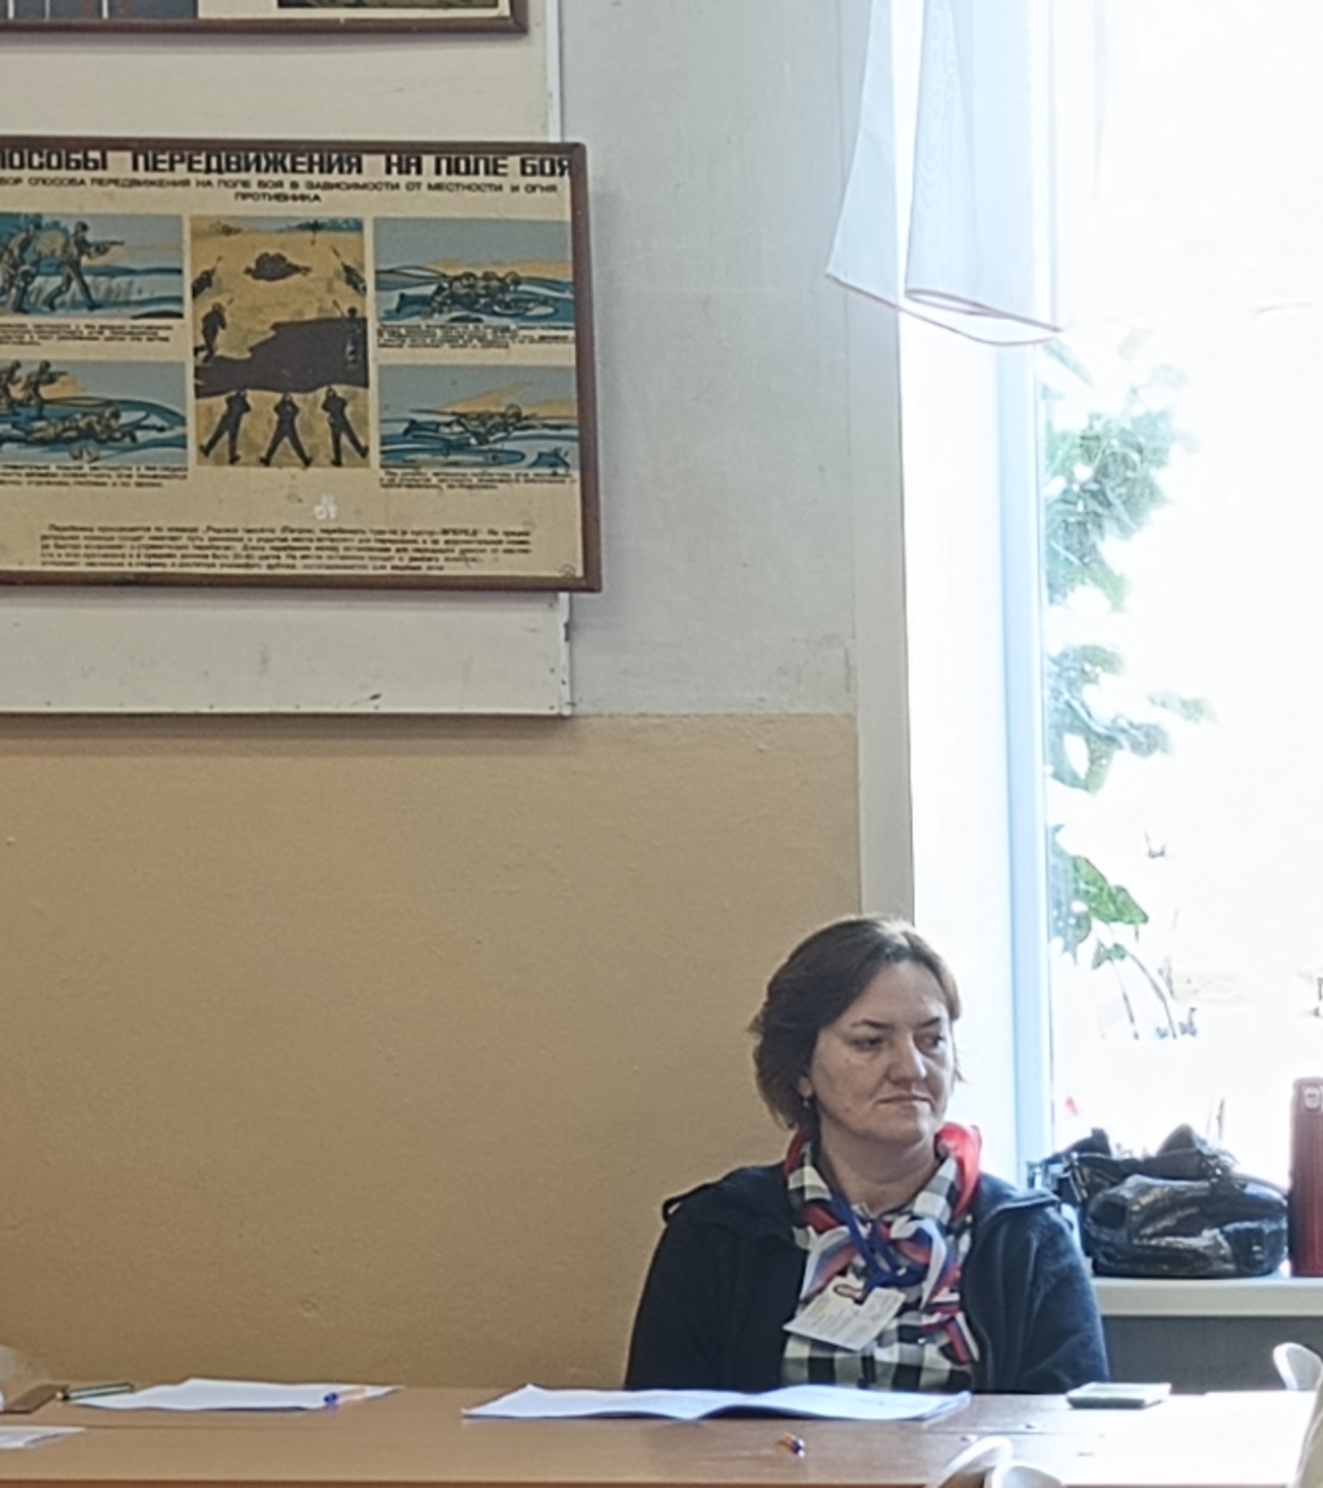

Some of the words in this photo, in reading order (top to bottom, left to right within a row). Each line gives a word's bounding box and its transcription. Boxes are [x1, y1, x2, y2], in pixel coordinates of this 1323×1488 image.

[0, 149, 108, 171] ОСОБЫ
[132, 150, 363, 175] ПЕРЕДВИЖЕНИЯ
[384, 155, 422, 175] НА
[434, 156, 508, 177] ПОЛЕ
[520, 156, 570, 178] БОЯ
[196, 179, 213, 188] НА
[218, 179, 251, 189] ПОЛЕ
[257, 180, 284, 190] БОЯ
[305, 181, 400, 192] ЗАВИСИМОСТИ
[405, 182, 422, 192] ОТ
[427, 182, 503, 193] МЕСТНОСТИ
[524, 183, 558, 195] ОГНЯ
[234, 191, 322, 203] ПРОТИВНИКА
